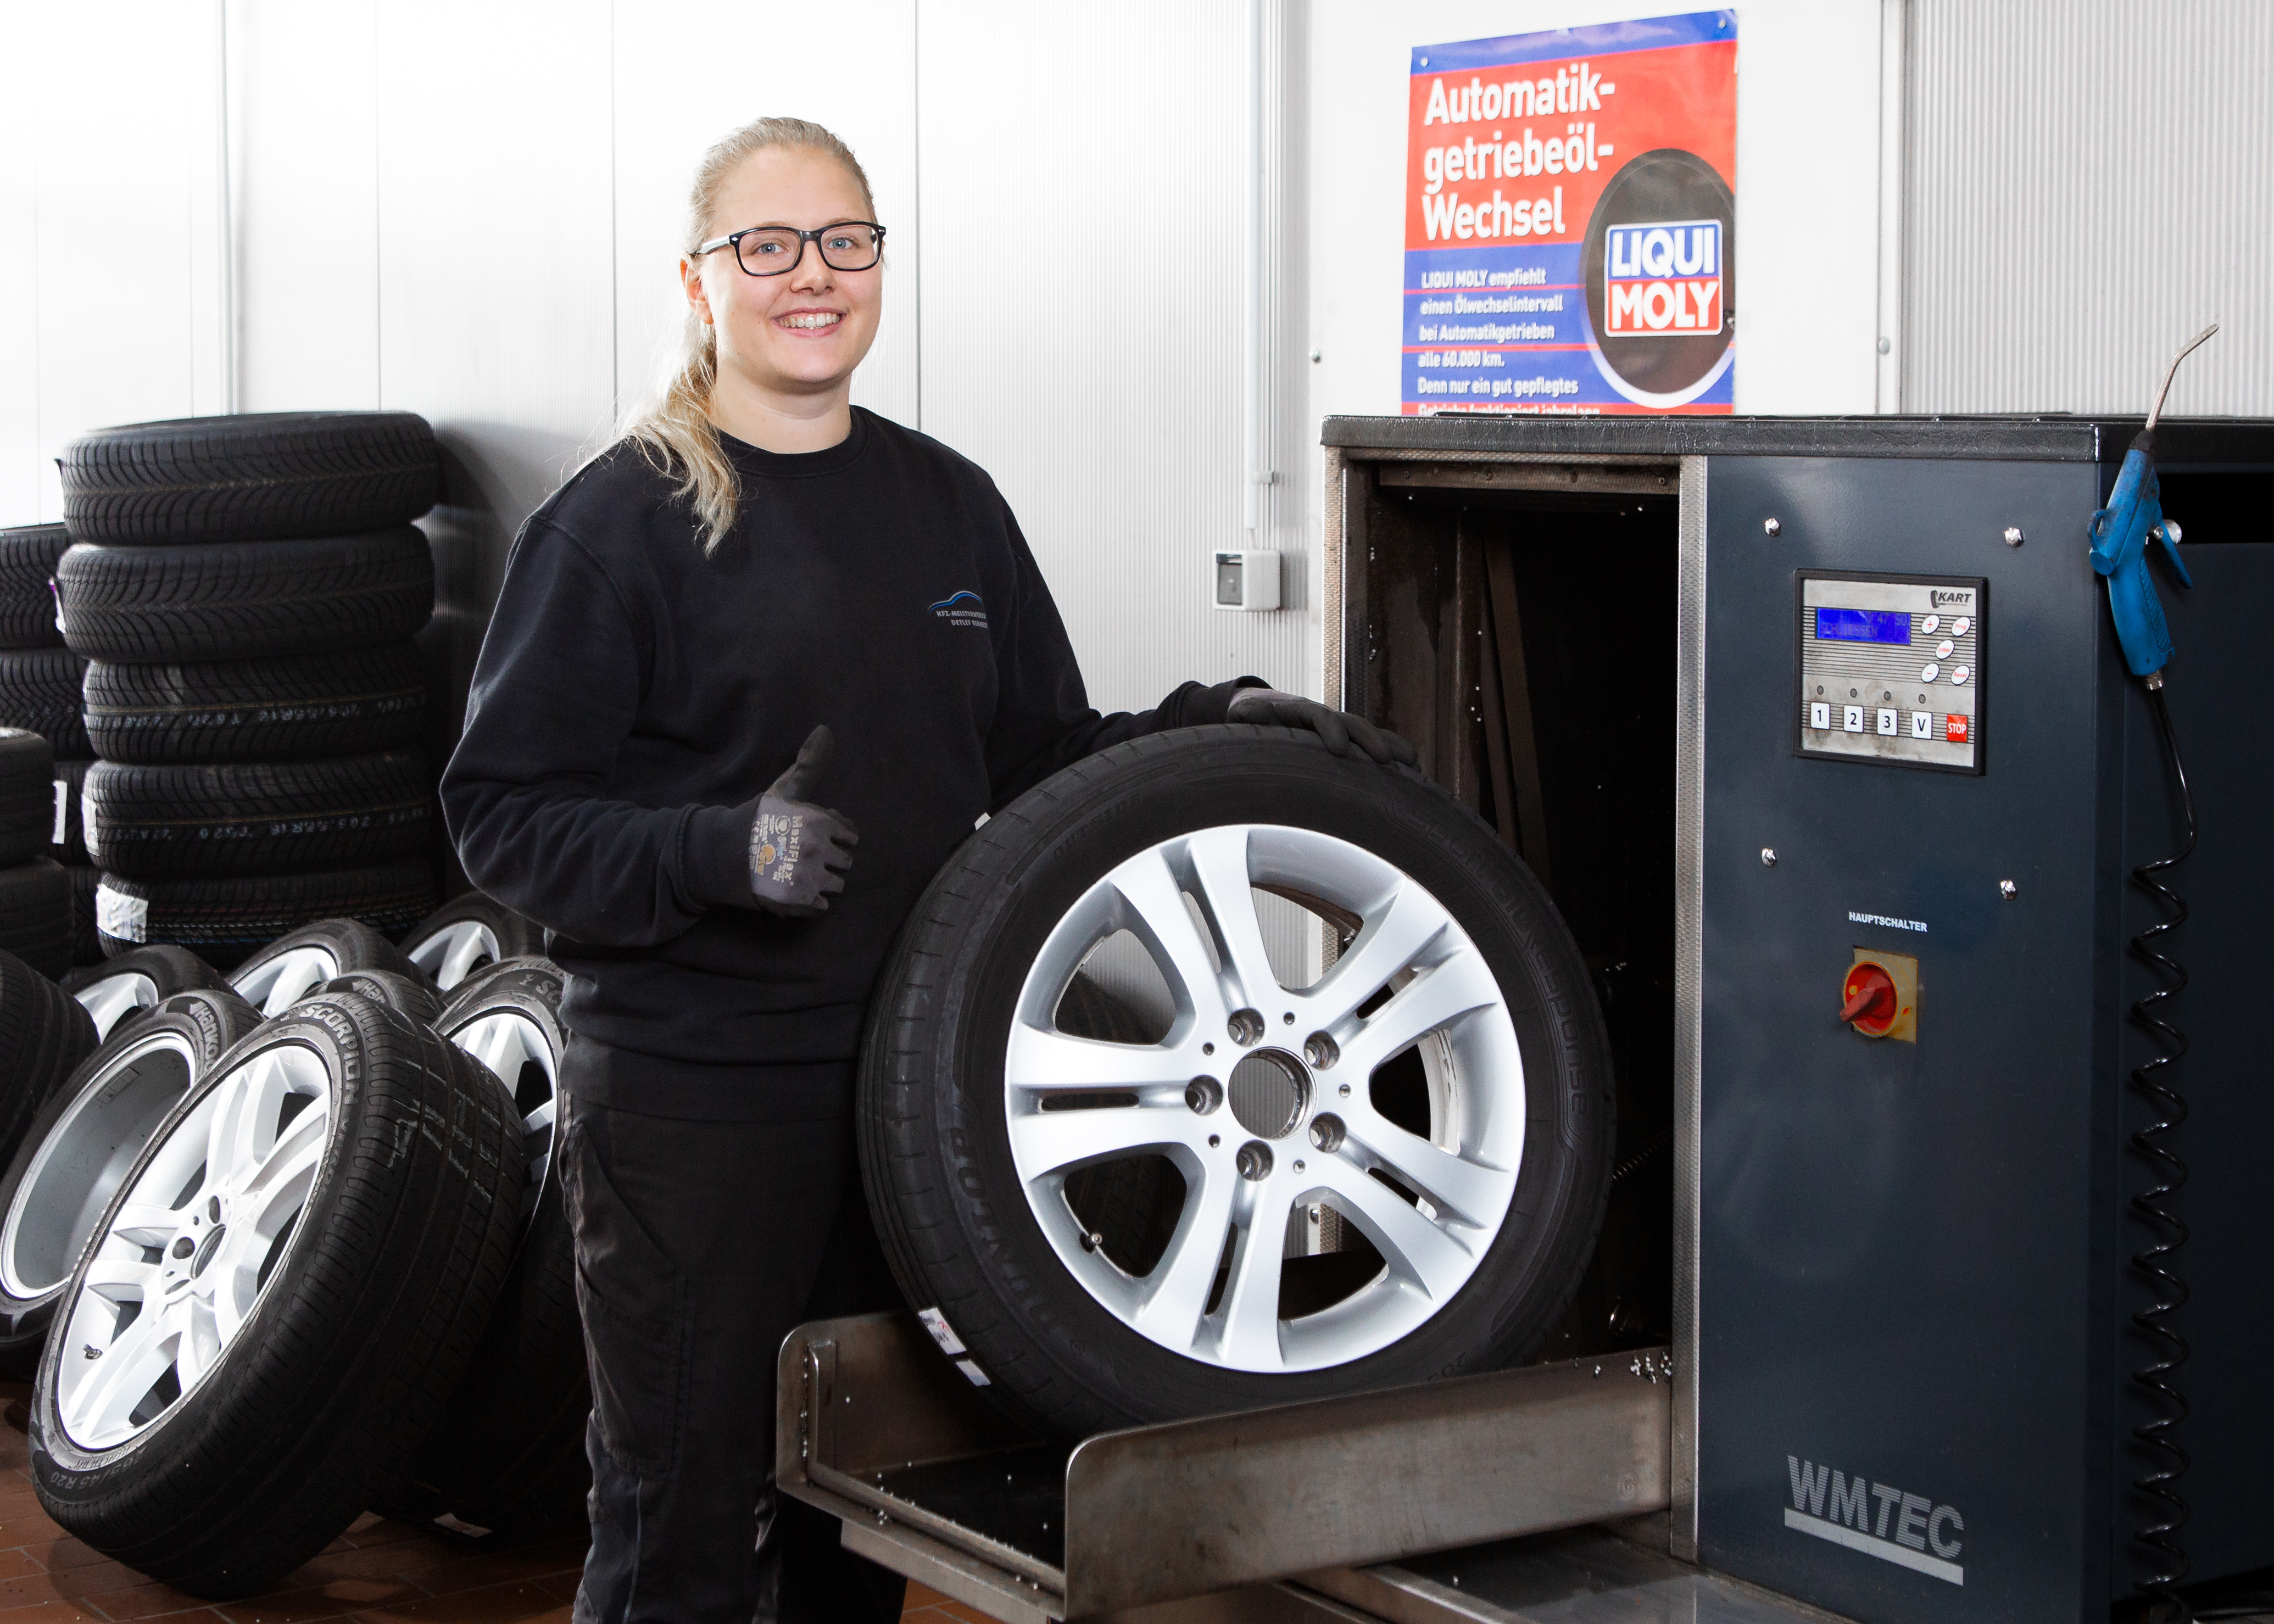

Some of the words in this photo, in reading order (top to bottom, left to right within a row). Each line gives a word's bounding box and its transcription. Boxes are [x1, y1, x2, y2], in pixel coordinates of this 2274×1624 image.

[1424, 63, 1615, 125] Automatik-
[1424, 123, 1614, 194] getriebeöl-
[1422, 186, 1565, 240] Wechsel
[1612, 228, 1715, 278] LIQUI
[1422, 271, 1453, 288] LIQUI
[1456, 270, 1488, 287] MOLY
[1489, 267, 1546, 289] empfiehlt
[1420, 298, 1453, 315] einen
[1454, 294, 1563, 315] Ölwechselintervall
[1611, 282, 1719, 329] MOLY
[1419, 324, 1437, 341] bei
[1439, 322, 1555, 344] Automatikgetrieben
[1418, 351, 1440, 367] alle
[1442, 351, 1481, 367] 60.000
[1483, 350, 1504, 367] km.
[1418, 377, 1447, 394] Denn
[1449, 380, 1470, 394] nur
[1472, 377, 1490, 394] ein
[1492, 378, 1512, 398] gut
[1514, 377, 1579, 398] gepflegtes
[1938, 592, 1972, 603] KART
[1955, 623, 1967, 631] Prog
[1817, 710, 1822, 722] 1
[1850, 712, 1857, 726] 2
[1884, 716, 1891, 728] 3
[1917, 718, 1926, 732] V
[1948, 723, 1967, 734] STOP
[1849, 911, 1927, 932] HAUPTSCHALTER
[196, 1006, 220, 1073] Hankoo
[301, 1004, 361, 1105] SCORPION
[950, 1125, 1063, 1337] DUNLOP
[1787, 1454, 1964, 1559] WMTEC
